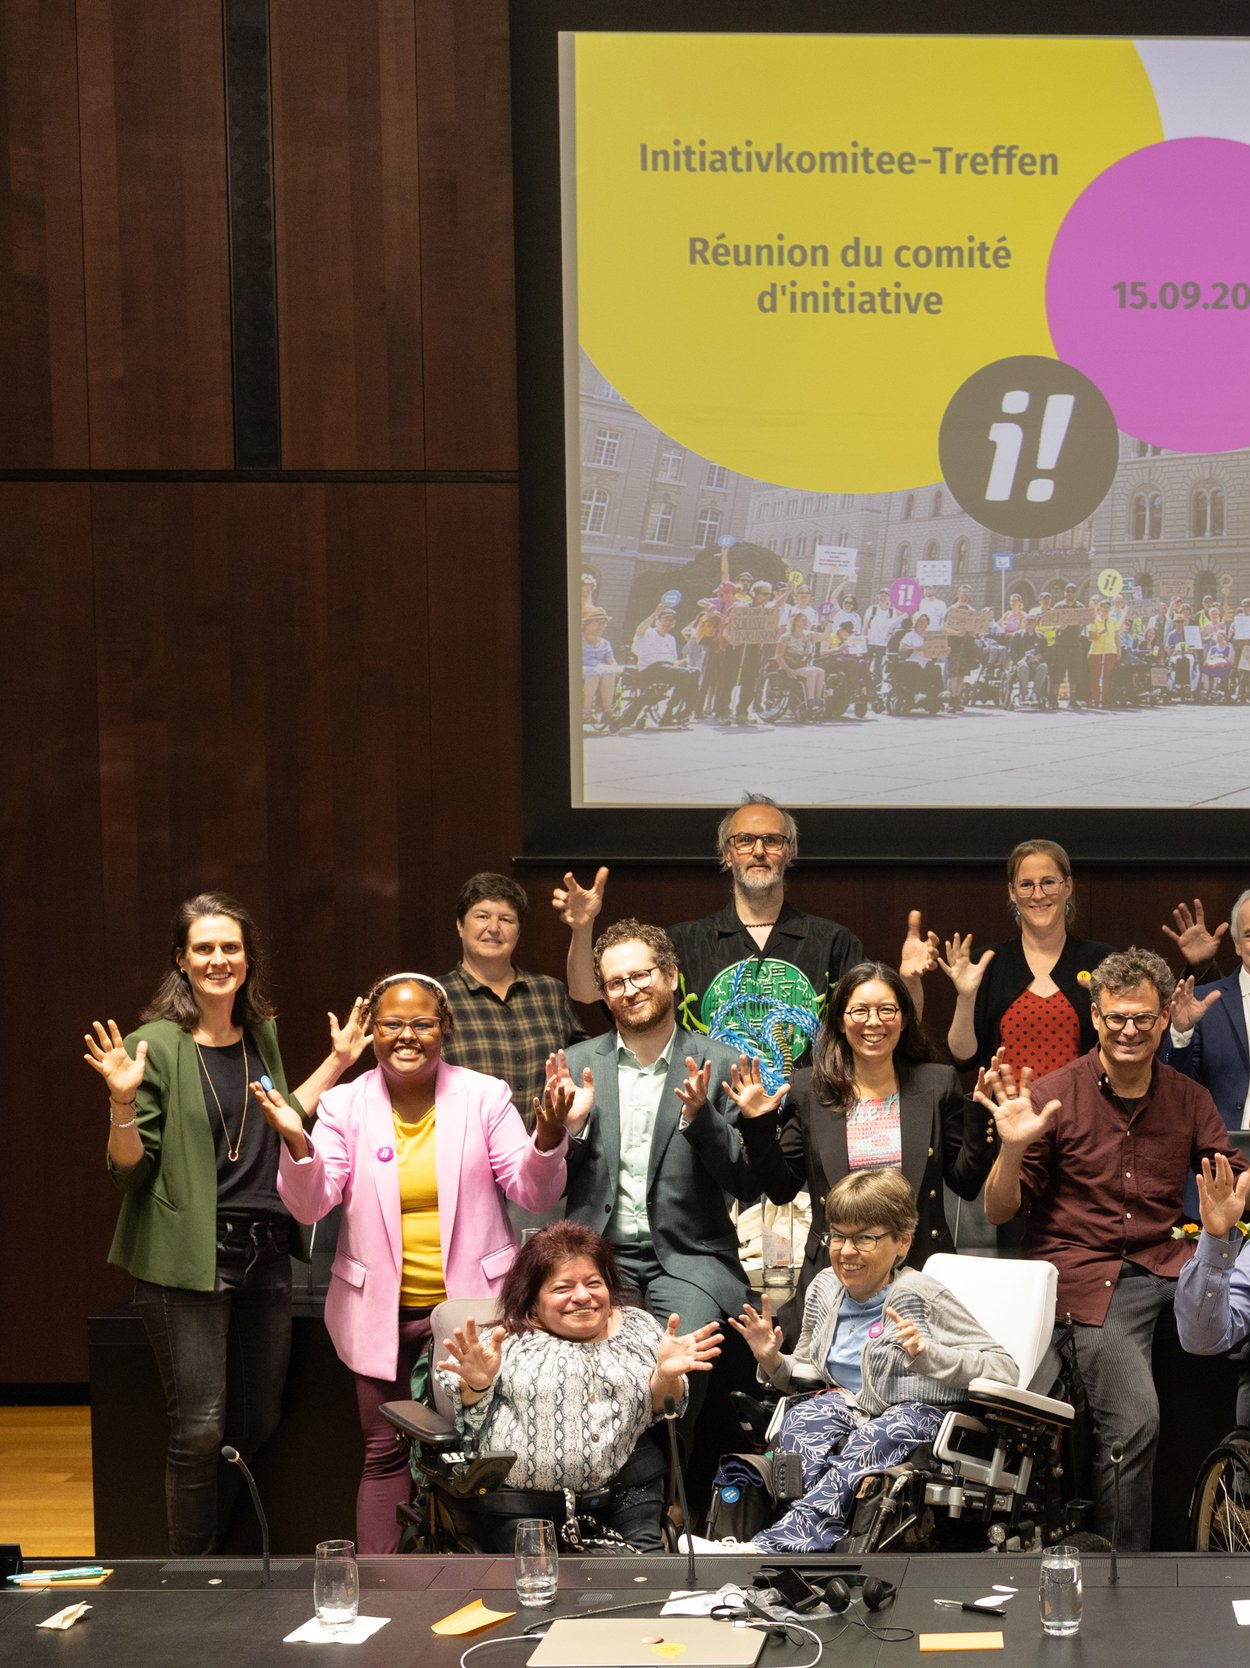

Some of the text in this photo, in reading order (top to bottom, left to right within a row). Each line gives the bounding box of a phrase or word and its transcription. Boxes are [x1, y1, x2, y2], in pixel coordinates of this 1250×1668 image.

[639, 138, 1059, 177] Initiativkomitee-Treffen
[688, 232, 1012, 270] Réunion du comité
[757, 279, 944, 315] d'initiative
[985, 390, 1075, 502] i!
